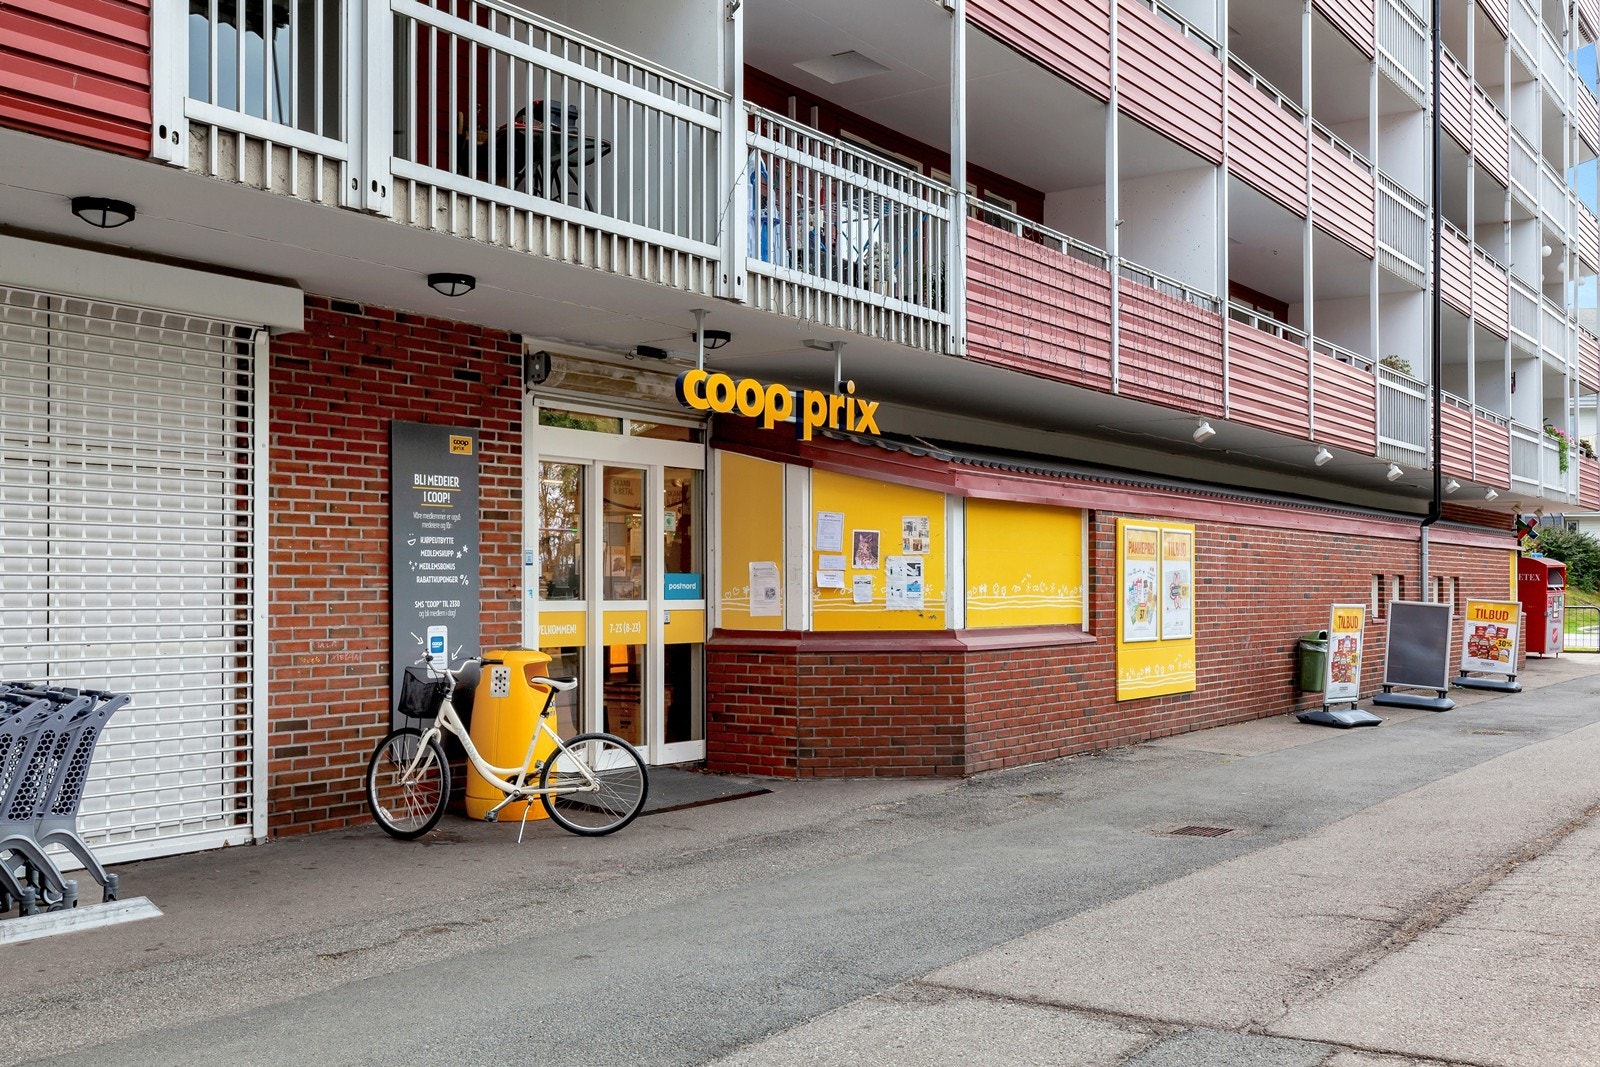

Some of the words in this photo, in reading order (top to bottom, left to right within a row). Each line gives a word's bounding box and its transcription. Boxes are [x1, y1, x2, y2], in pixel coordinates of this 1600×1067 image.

[681, 368, 793, 429] coop
[802, 378, 881, 442] prix
[414, 473, 426, 486] BLI
[427, 474, 460, 488] MEDEIER
[613, 479, 631, 487] SKANN
[427, 491, 451, 504] COOP!
[413, 511, 423, 519] Våre
[423, 512, 446, 520] medlemmer
[420, 536, 454, 545] KJØPEUTBYTTE
[420, 549, 454, 557] MEDLEMSKUPP
[1128, 540, 1156, 556] PAKKEPRIS
[1167, 541, 1187, 557] TILBUD
[419, 562, 456, 570] MEDLEMSBONUS
[416, 575, 459, 583] RABATTKUPONGER
[668, 582, 697, 590] postnord
[414, 600, 425, 608] SMS
[1475, 608, 1509, 621] TILBUD
[609, 623, 623, 634] 7-23
[623, 621, 641, 634] (8-23)
[1338, 615, 1359, 629] TILBUD
